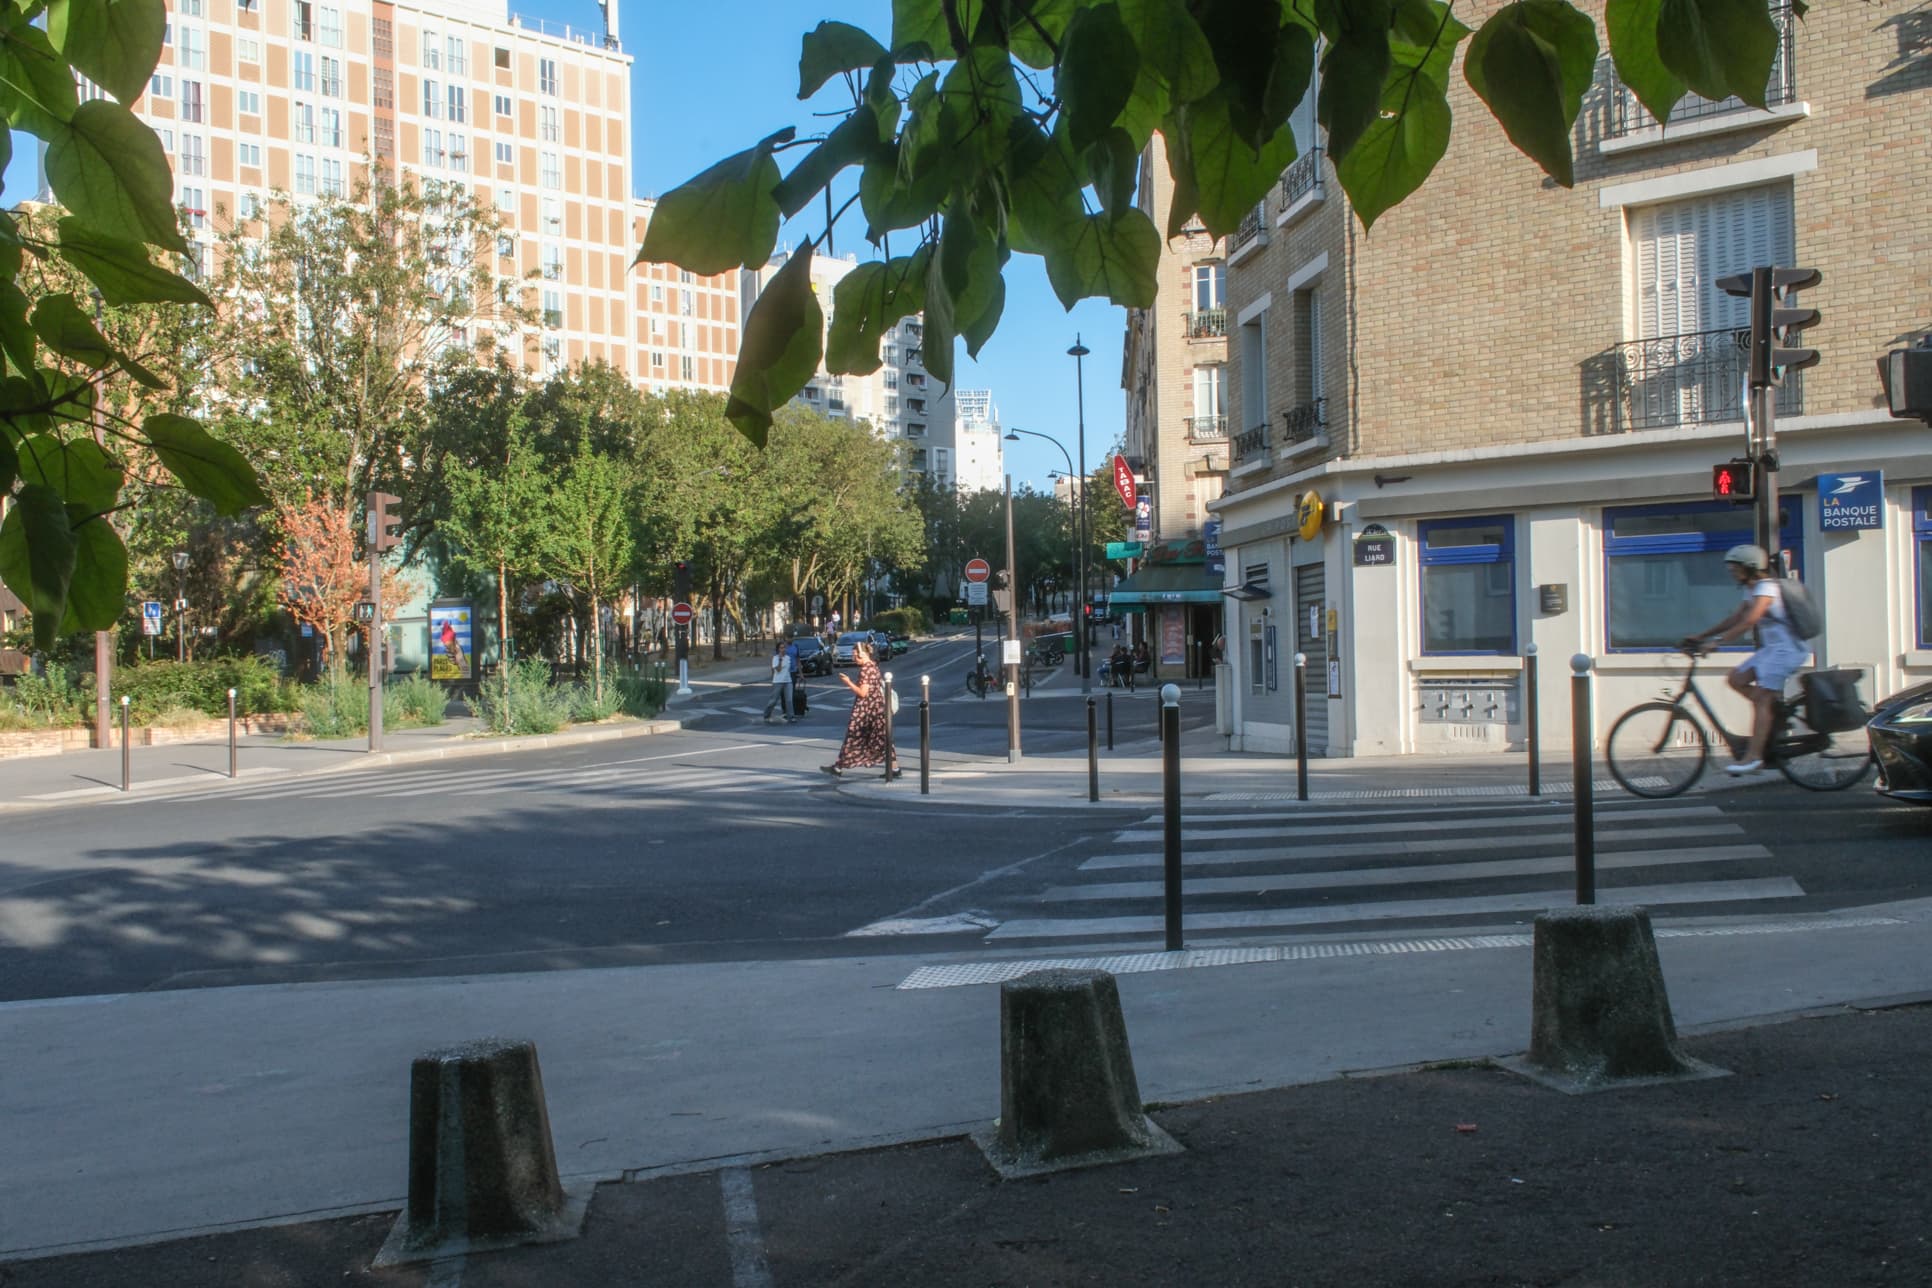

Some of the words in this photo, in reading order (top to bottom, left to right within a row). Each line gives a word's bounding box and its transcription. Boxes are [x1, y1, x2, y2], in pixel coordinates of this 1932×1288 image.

[1118, 467, 1132, 498] TABAC
[1823, 498, 1840, 507] LA
[1823, 505, 1877, 517] BANQUE
[1824, 516, 1878, 528] POSTALE
[1367, 544, 1382, 552] RUE
[1364, 554, 1385, 562] LIARD
